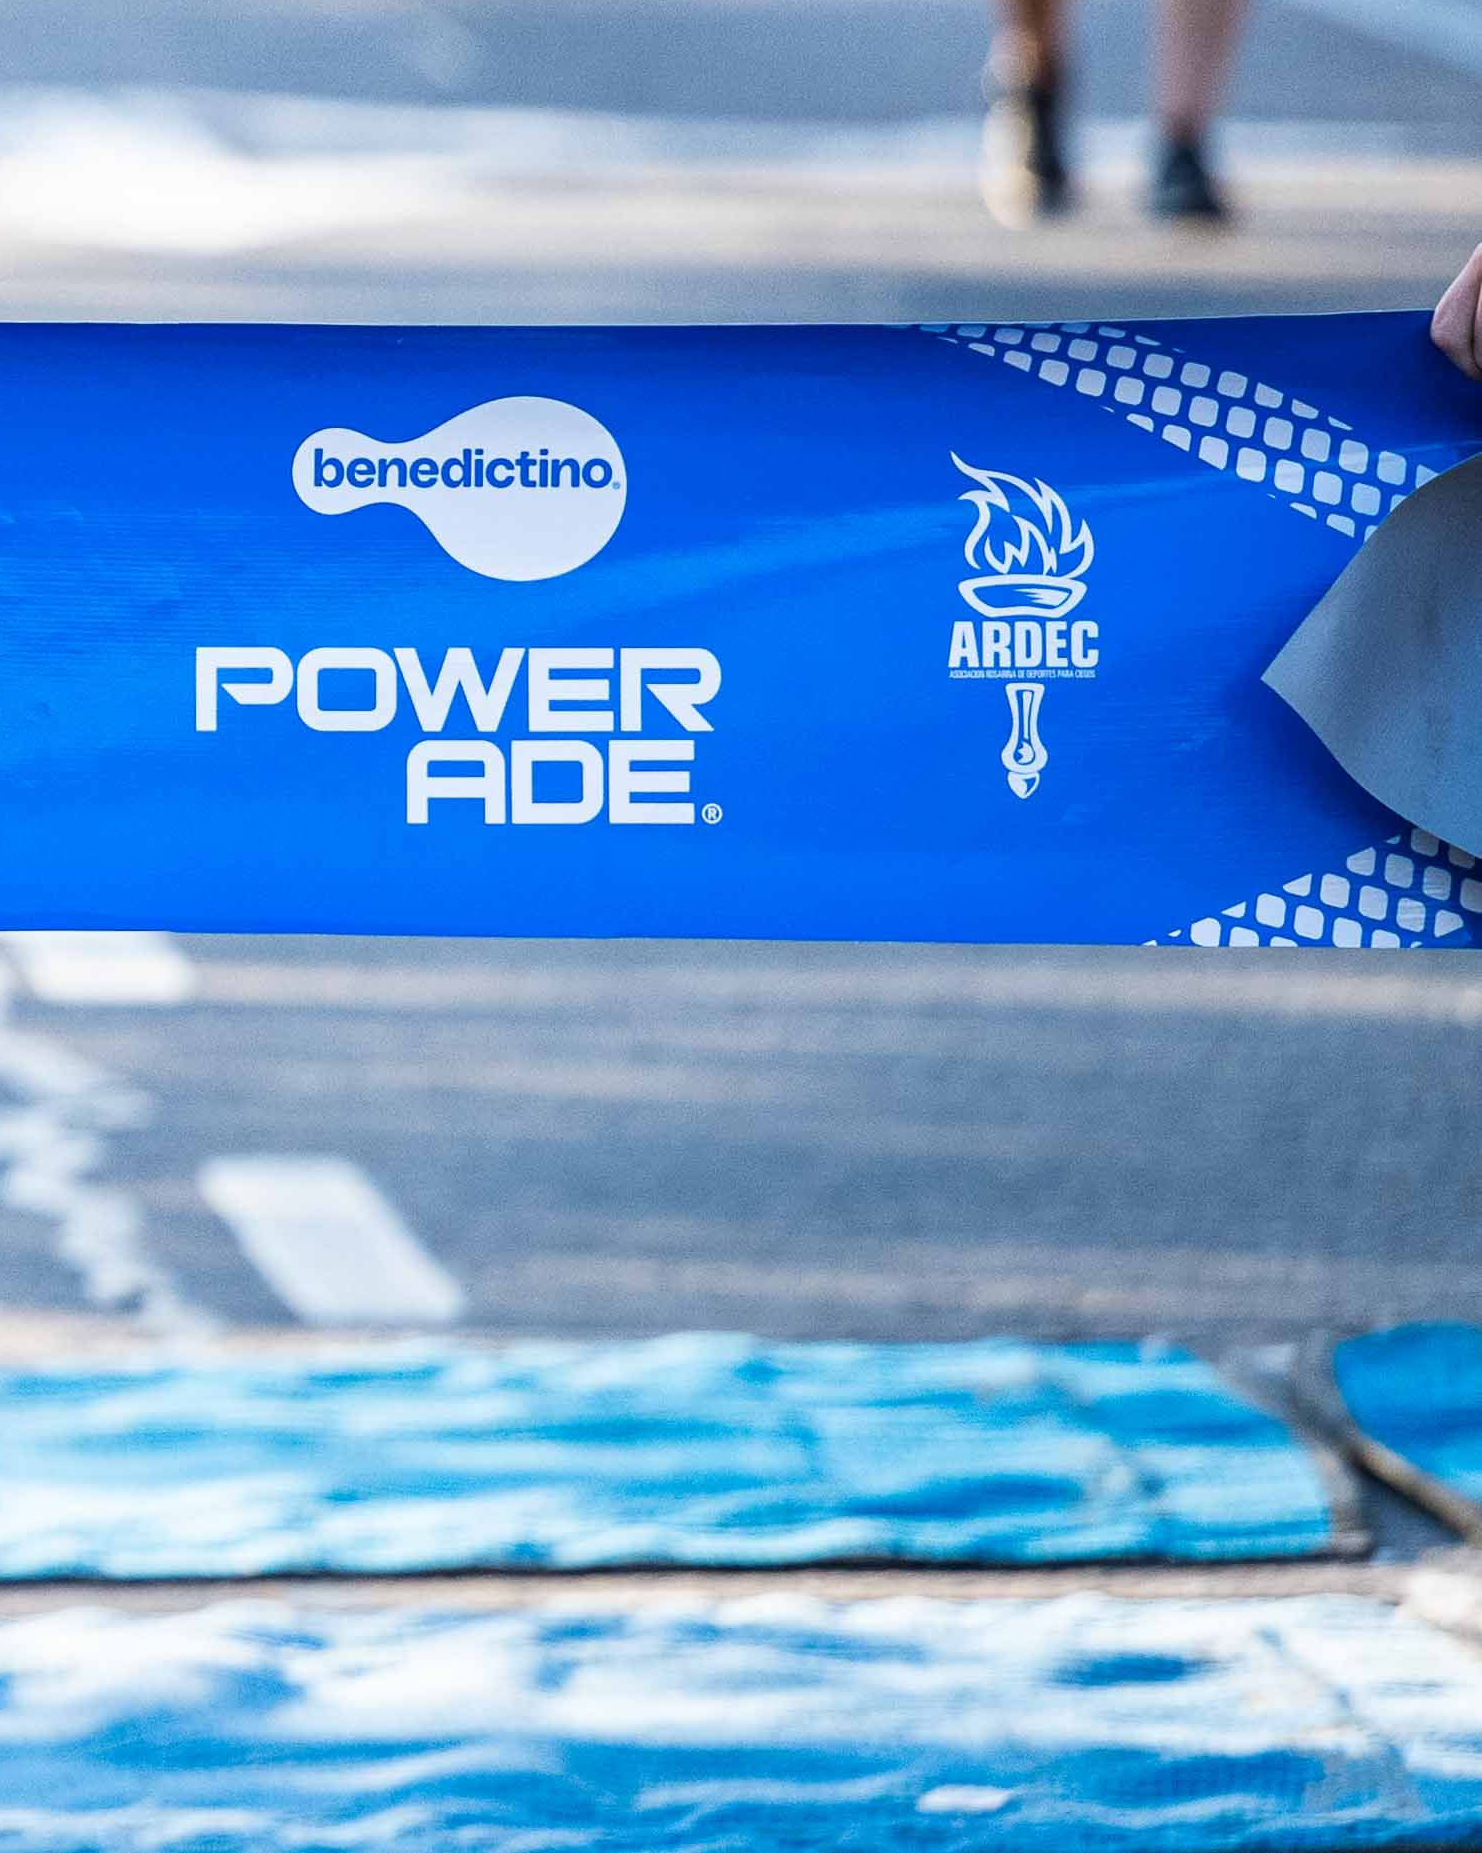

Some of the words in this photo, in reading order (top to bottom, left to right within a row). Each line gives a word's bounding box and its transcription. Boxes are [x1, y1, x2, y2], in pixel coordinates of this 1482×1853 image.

[313, 448, 613, 490] benedictino
[948, 621, 1099, 668] ARDEC
[196, 647, 722, 732] POWER
